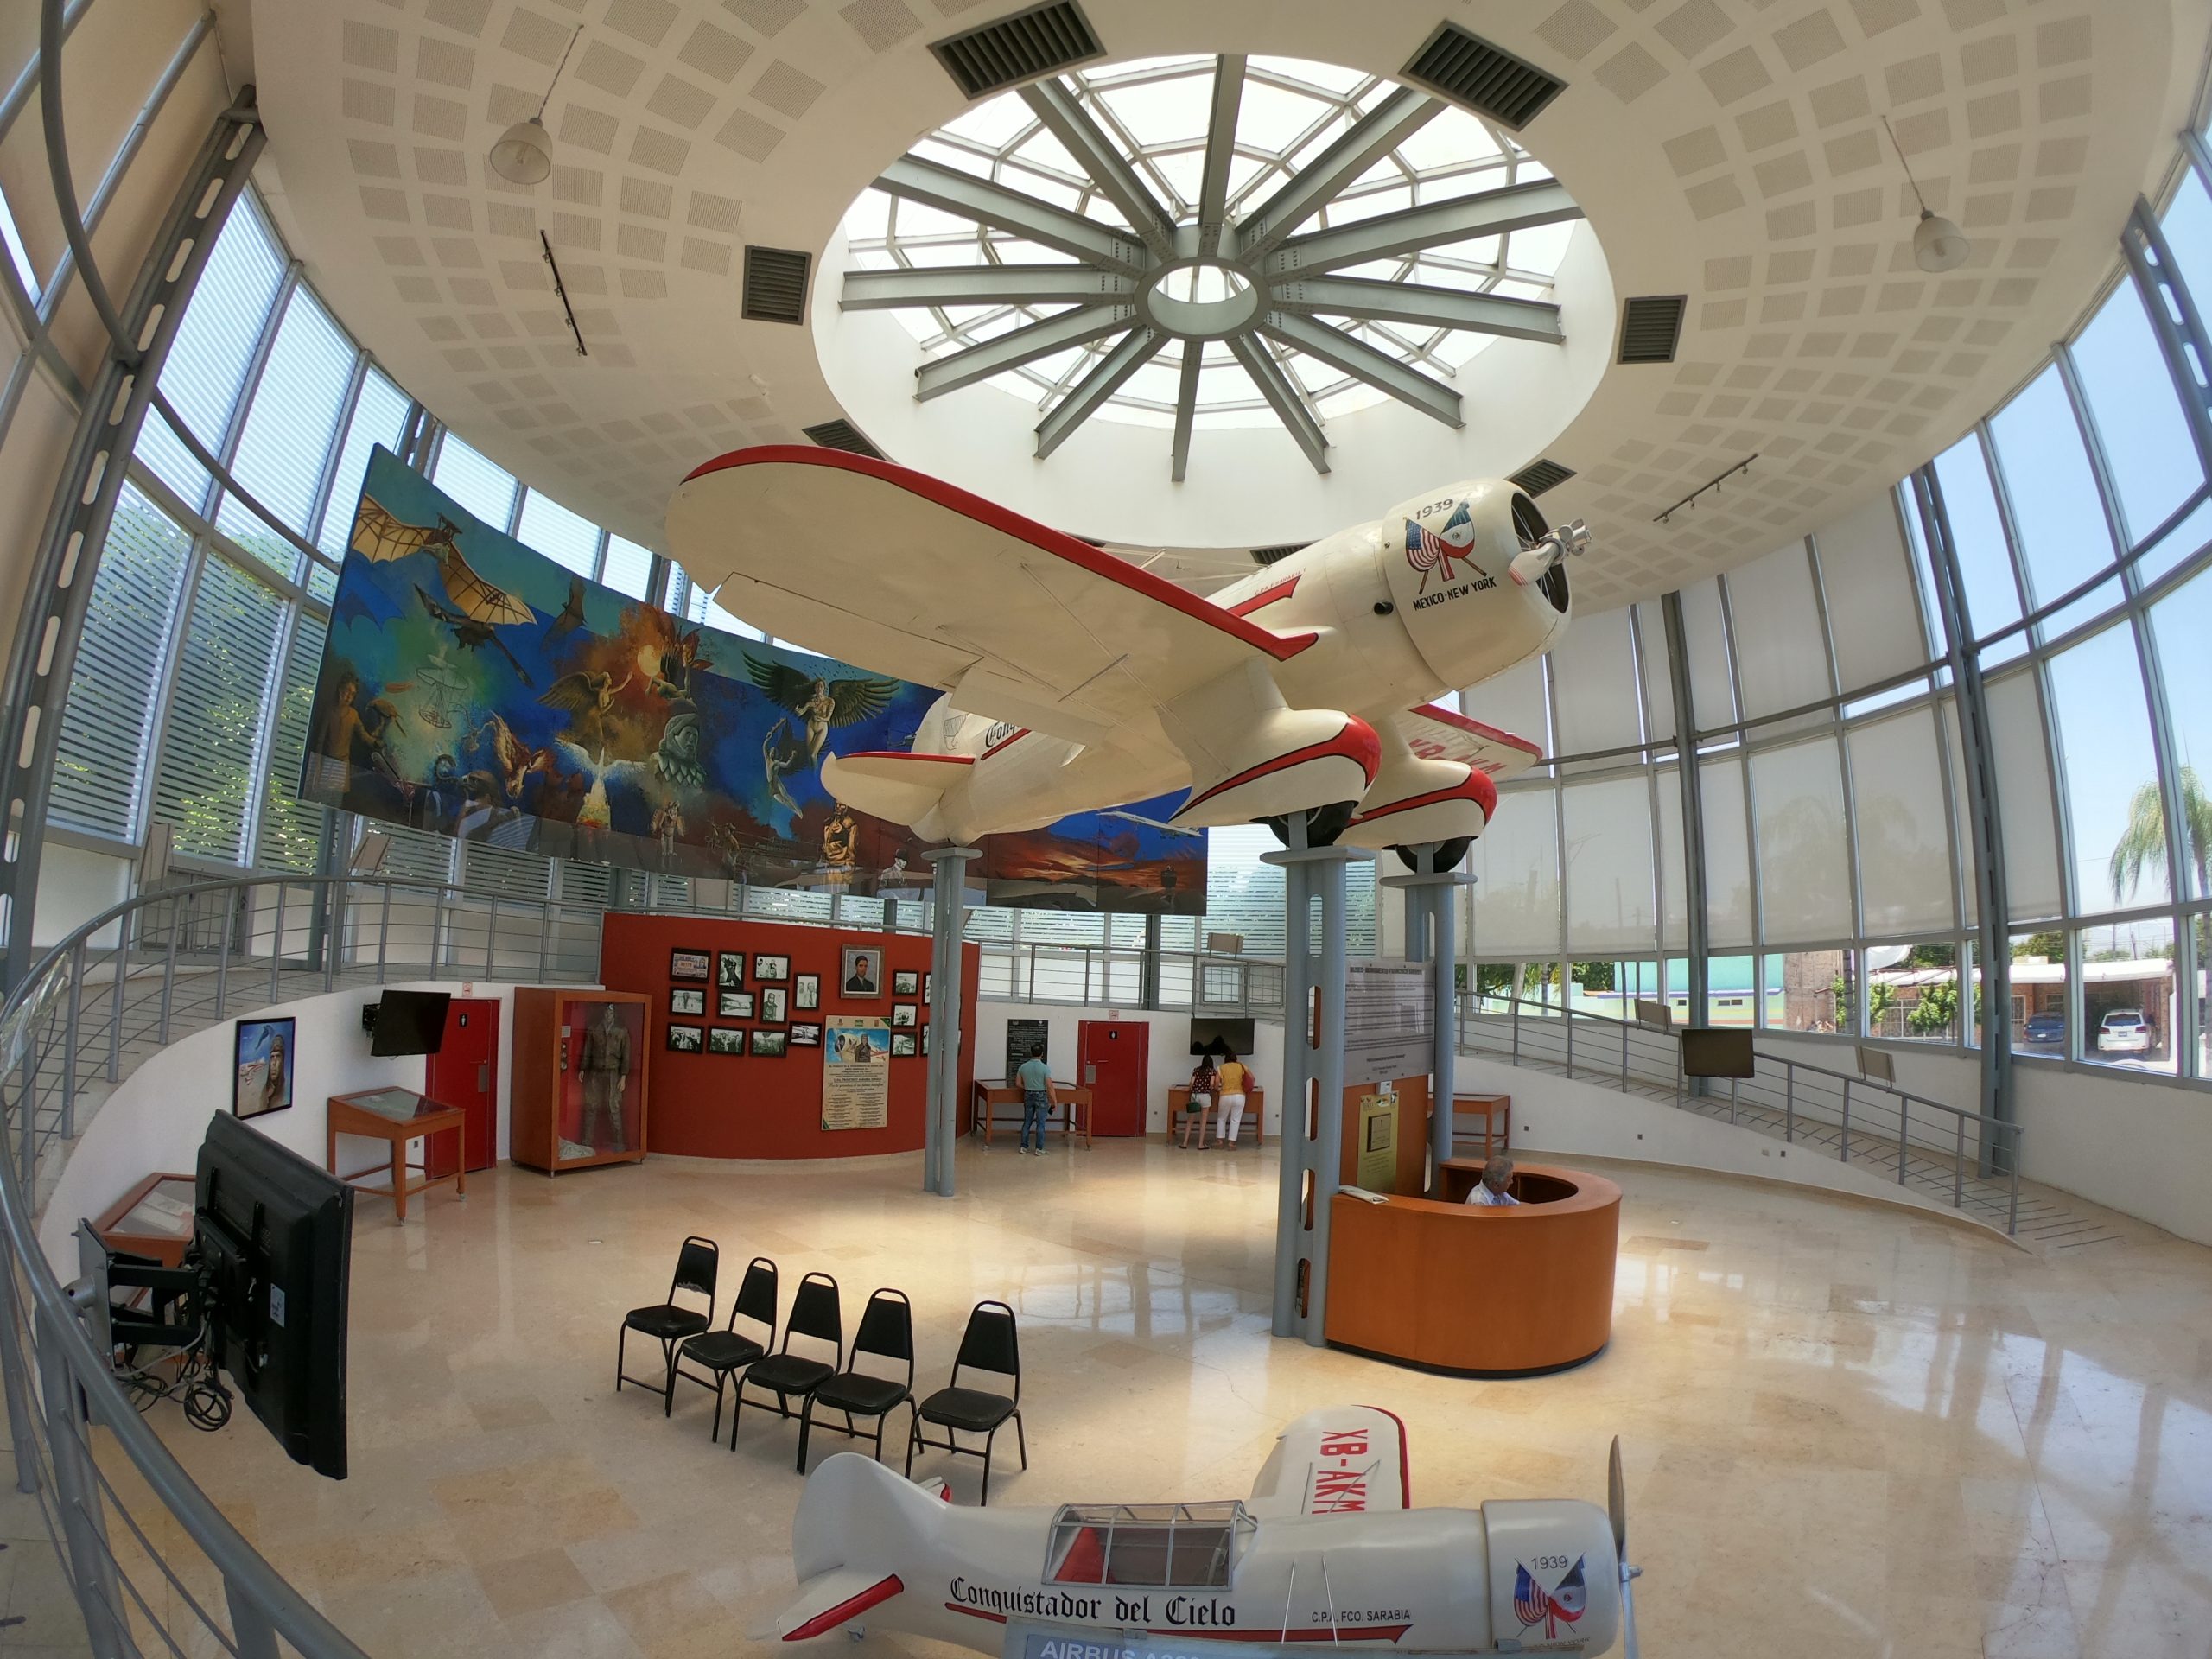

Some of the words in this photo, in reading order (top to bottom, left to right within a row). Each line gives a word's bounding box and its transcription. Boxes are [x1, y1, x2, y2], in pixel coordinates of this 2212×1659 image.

[1416, 499, 1453, 519] 1939
[1471, 576, 1497, 592] YORK
[1312, 1428, 1368, 1514] XB-AKM
[1531, 1555, 1567, 1570] 1939
[950, 1577, 1102, 1620] Conquistador
[1116, 1595, 1151, 1623] del
[1166, 1596, 1235, 1626] Cielo
[1341, 1611, 1363, 1622] FCO.
[1367, 1610, 1411, 1621] SARABIA
